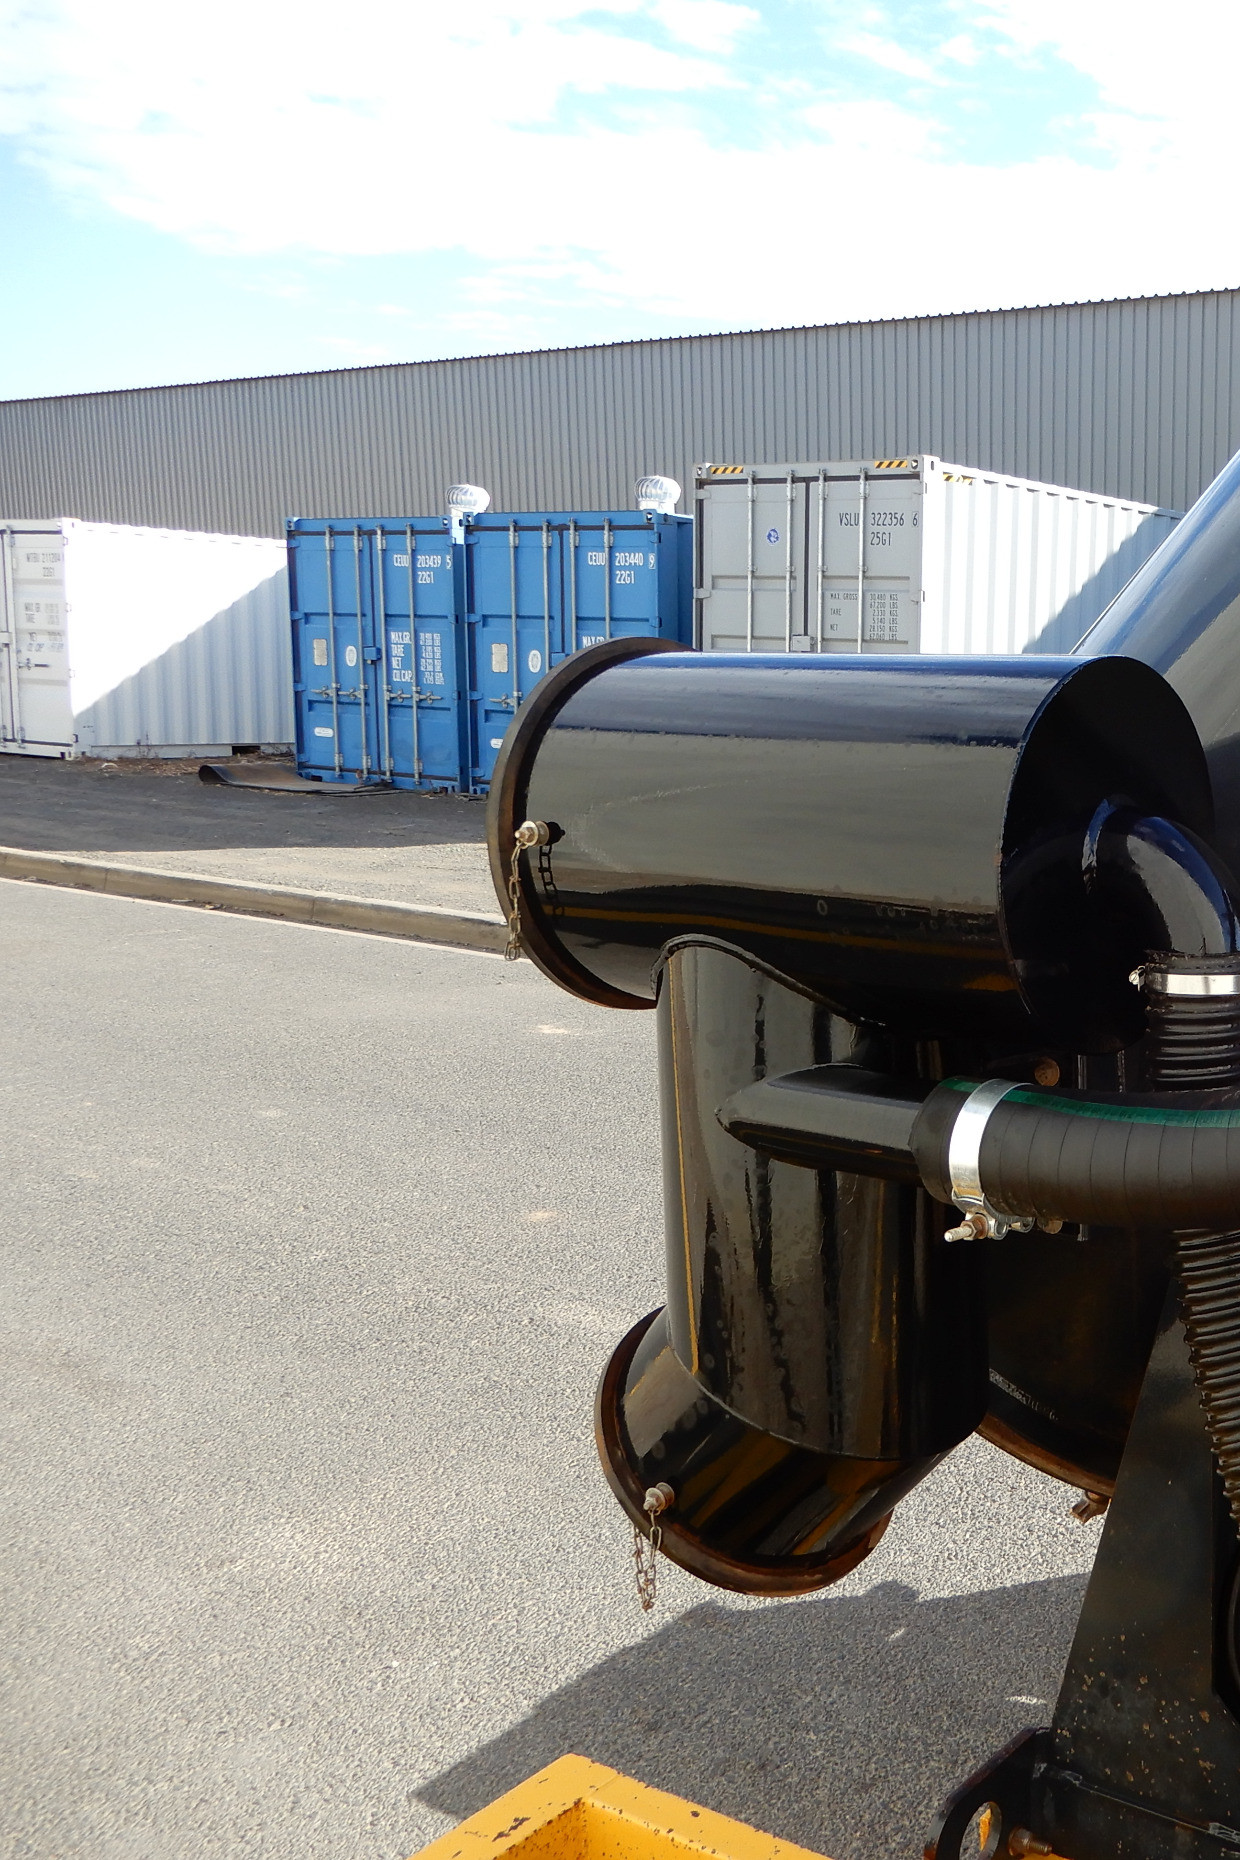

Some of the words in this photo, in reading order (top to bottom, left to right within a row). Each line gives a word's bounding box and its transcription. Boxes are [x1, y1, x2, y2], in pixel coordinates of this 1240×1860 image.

[839, 512, 860, 526] VSLU
[871, 512, 904, 526] 322356
[912, 512, 918, 527] 6
[870, 531, 891, 546] 25G1
[417, 555, 442, 568] 203439
[615, 552, 644, 566] 203440
[417, 571, 434, 584] 22G1
[615, 570, 635, 584] 22G1
[391, 644, 405, 657] TARE
[391, 657, 402, 669] NET
